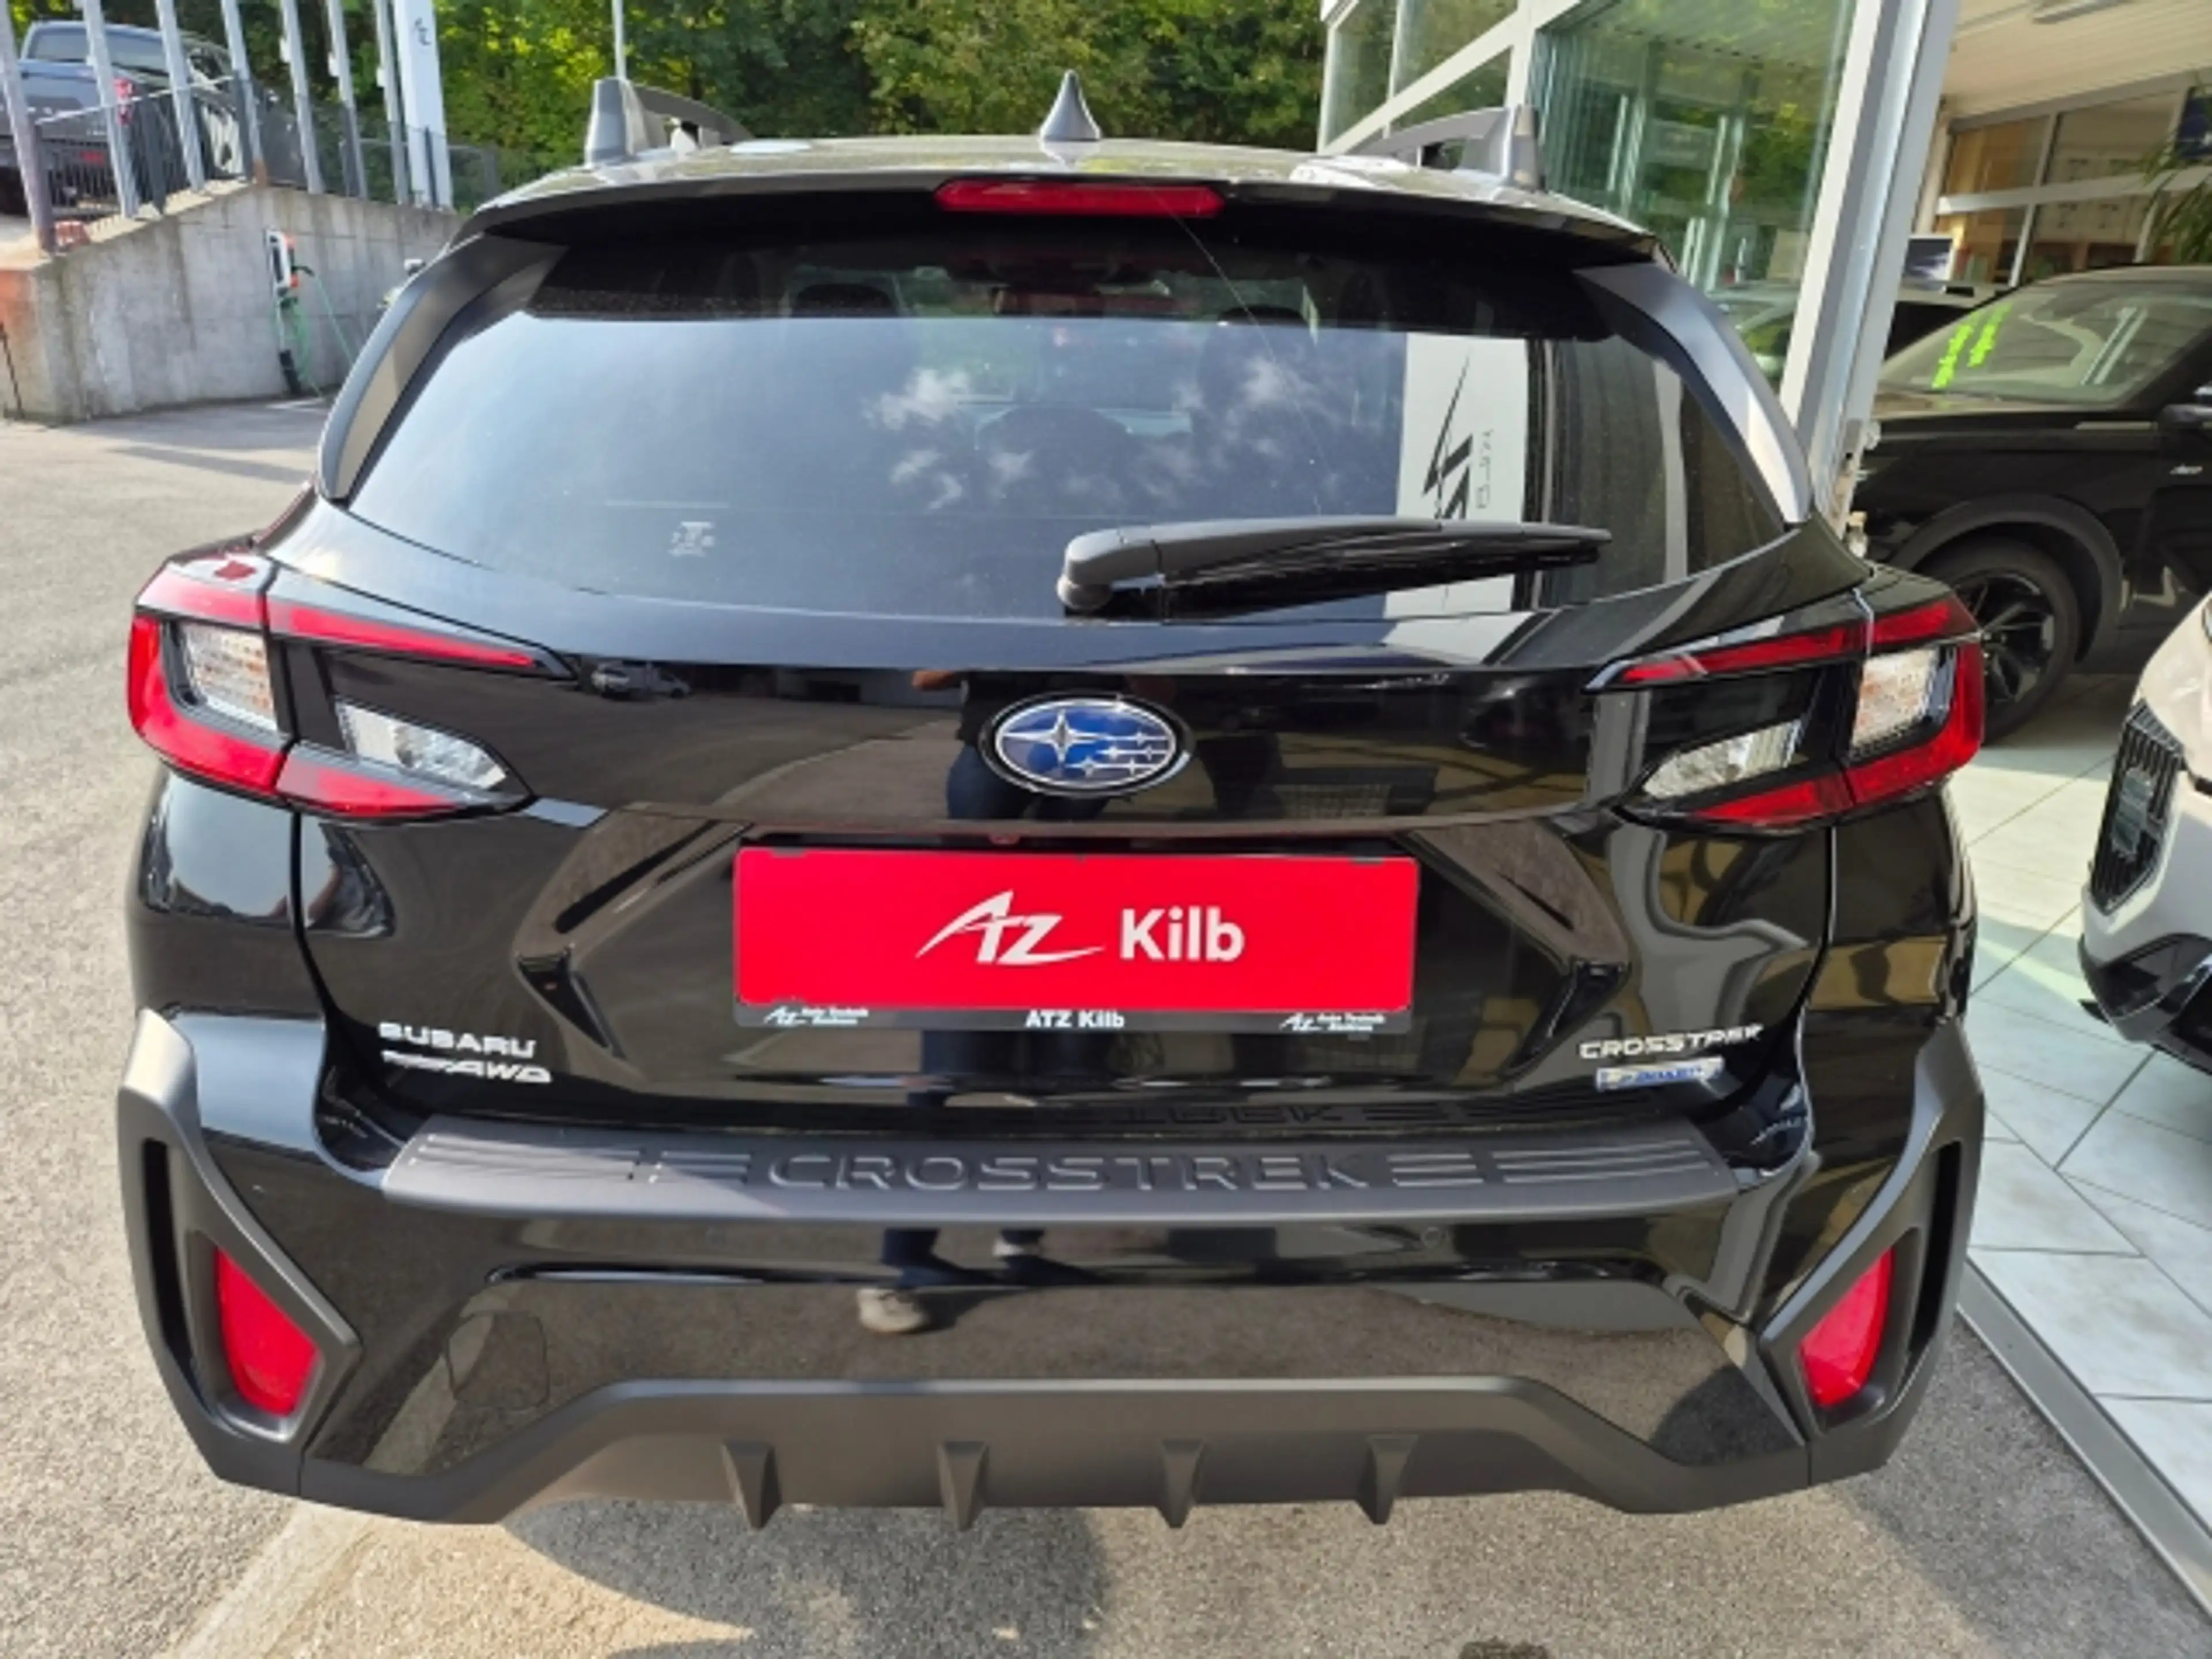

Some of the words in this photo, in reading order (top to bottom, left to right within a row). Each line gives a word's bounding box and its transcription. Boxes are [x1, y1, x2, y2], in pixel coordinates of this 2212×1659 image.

[1121, 906, 1245, 961] Kilb
[1025, 1009, 1072, 1028] ATZ
[1078, 1010, 1125, 1028] Kilb
[378, 1022, 536, 1059] SUBARU
[1580, 1023, 1764, 1059] CROSSTREK
[768, 1155, 1369, 1191] CROSSTREK
